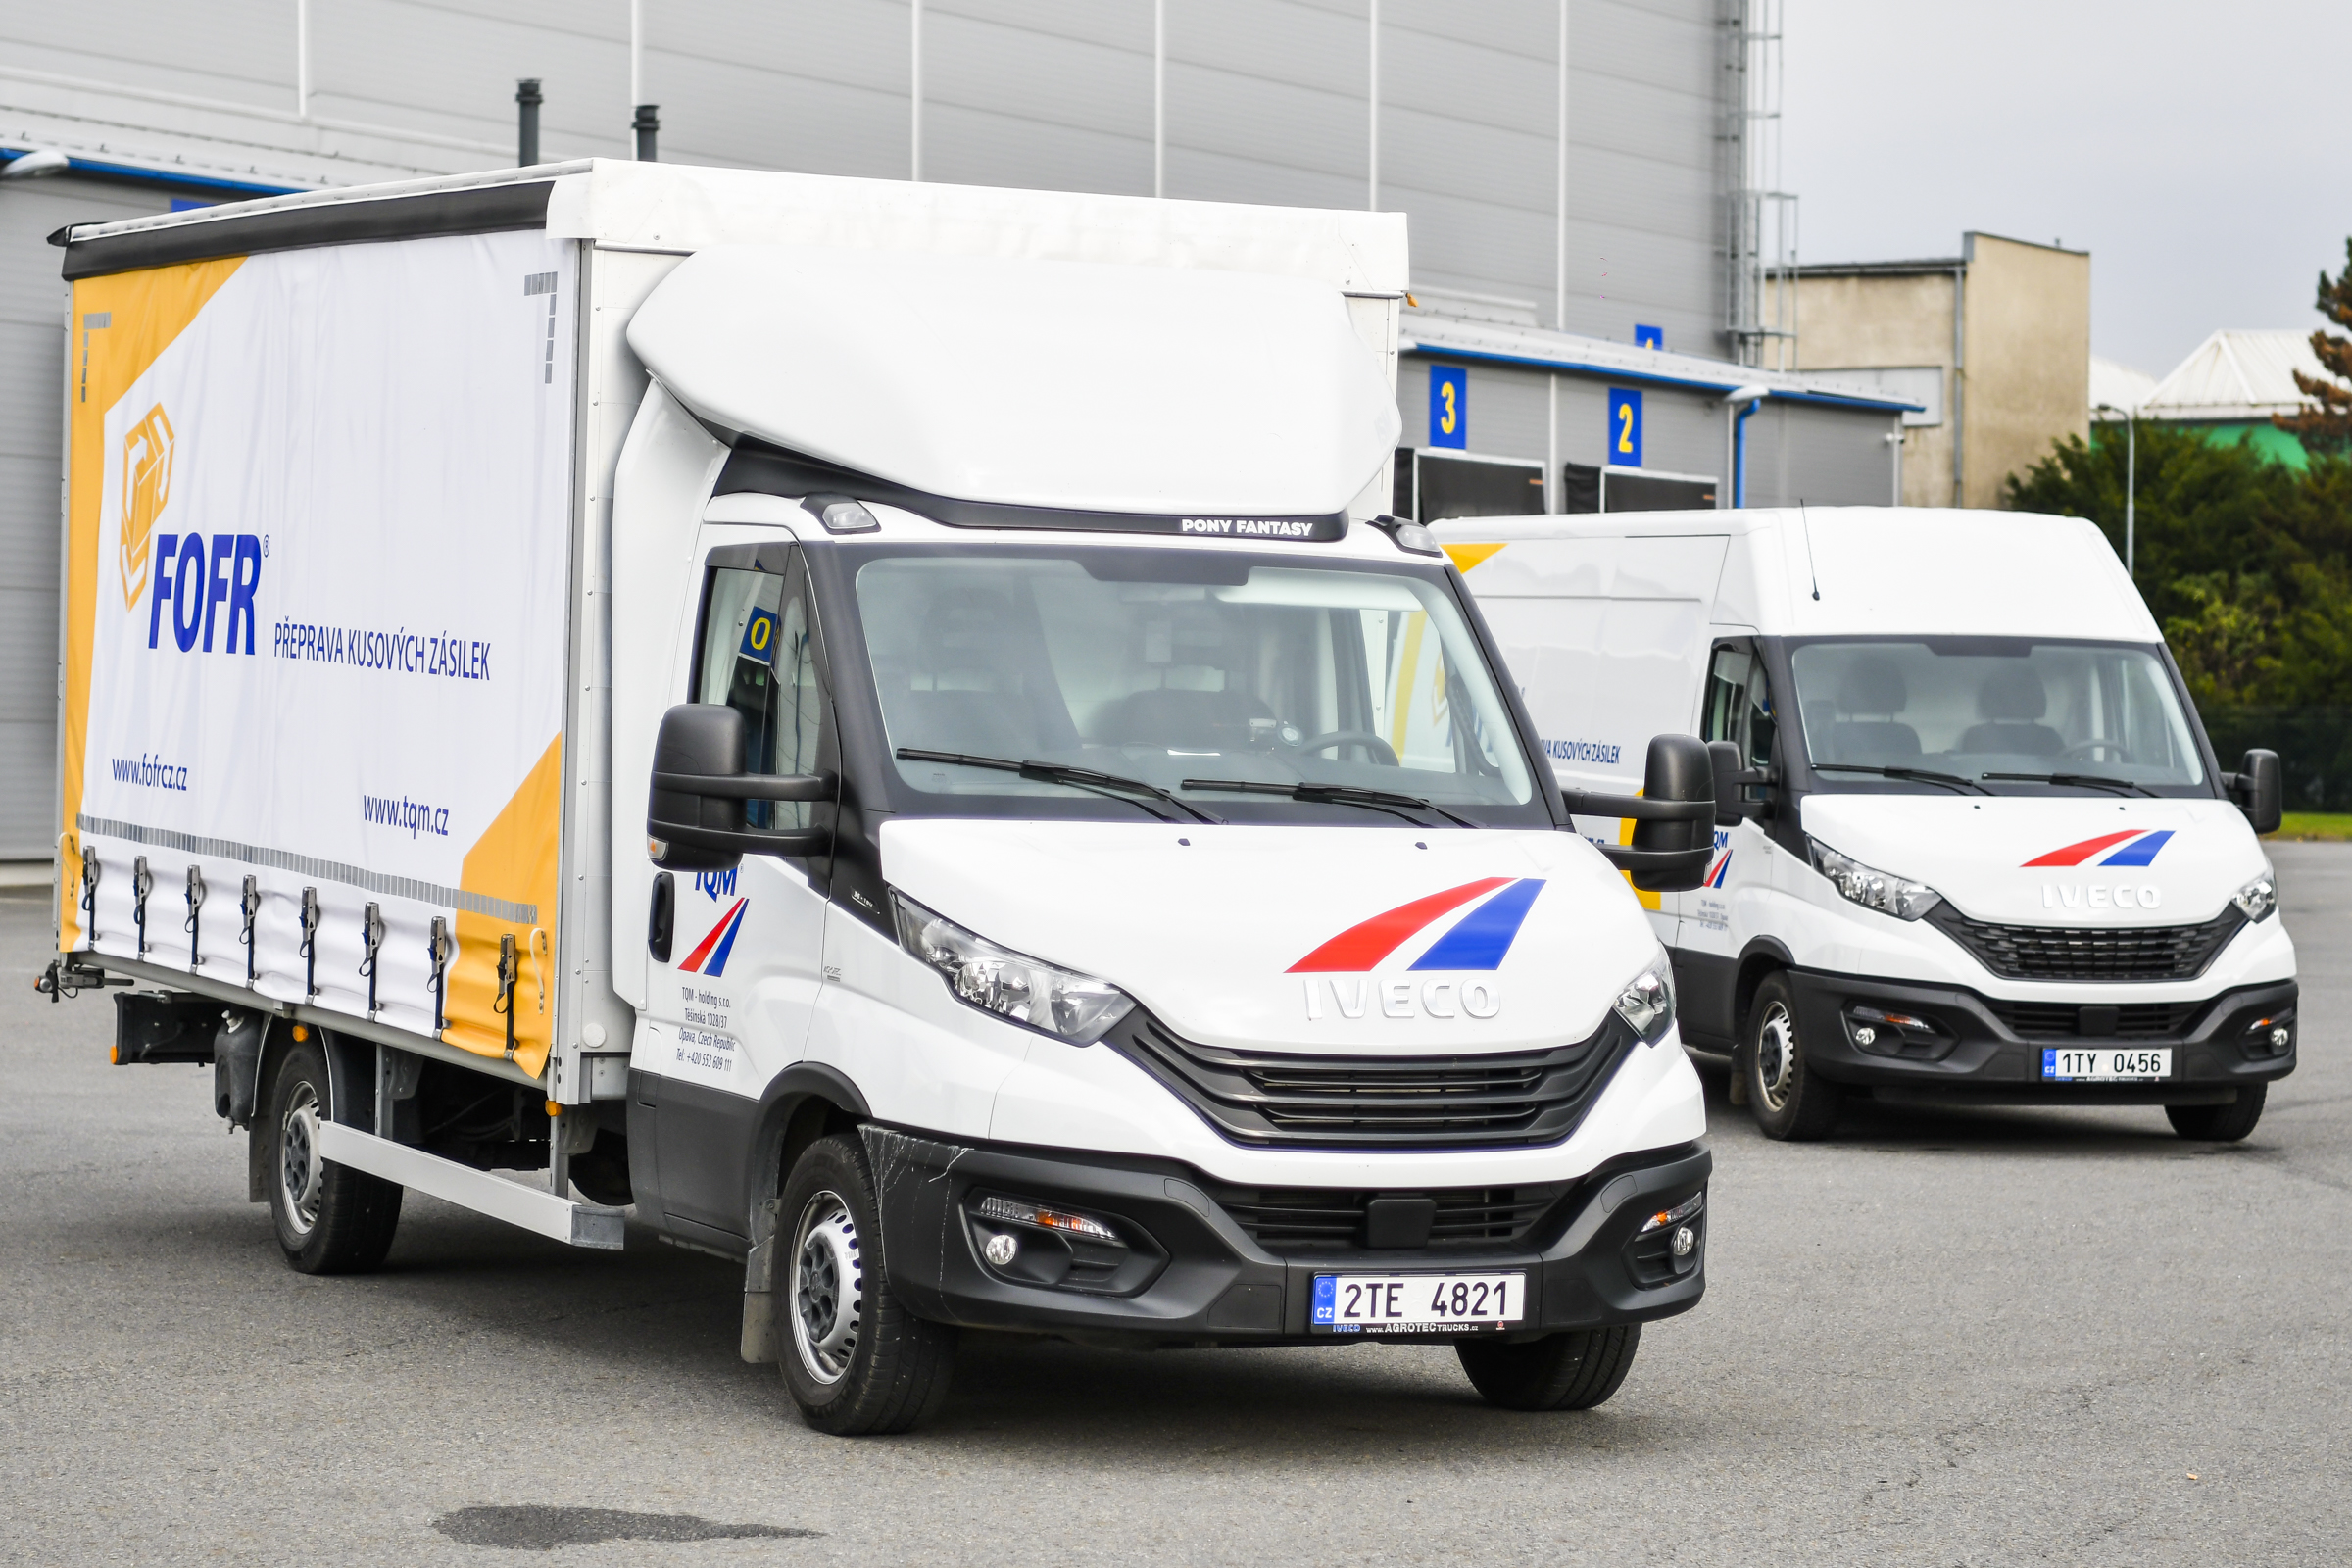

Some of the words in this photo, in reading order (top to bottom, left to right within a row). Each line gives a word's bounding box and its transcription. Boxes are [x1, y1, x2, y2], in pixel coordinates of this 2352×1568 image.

[1441, 381, 1456, 434] 3
[1618, 403, 1634, 453] 2
[1181, 518, 1232, 533] PONY
[1236, 520, 1313, 536] FANTASY
[274, 615, 344, 663] PŘEPRAVA
[348, 626, 425, 673] KUSOVÝCH
[428, 630, 491, 681] ZÁSILEK
[1552, 738, 1592, 761] KUSOVÝCH
[1591, 739, 1621, 764] ZÁSILEK
[112, 752, 187, 791] www.fofrcz.cz
[364, 794, 449, 840] www.tqm.cz
[1713, 830, 1729, 851] QM
[2042, 884, 2162, 909] IVECO
[682, 987, 694, 1003] TQM
[698, 989, 718, 1009] holding
[1302, 978, 1501, 1020] IVECO
[698, 1031, 713, 1047] Czech
[712, 1035, 736, 1052] Republic
[702, 1054, 712, 1068] 553
[2044, 1065, 2055, 1074] CZ
[2062, 1053, 2097, 1074] 1TY
[2113, 1053, 2161, 1074] 0456
[1344, 1283, 1404, 1318] 2TE
[1431, 1281, 1507, 1316] 4821
[1316, 1307, 1333, 1318] CZ
